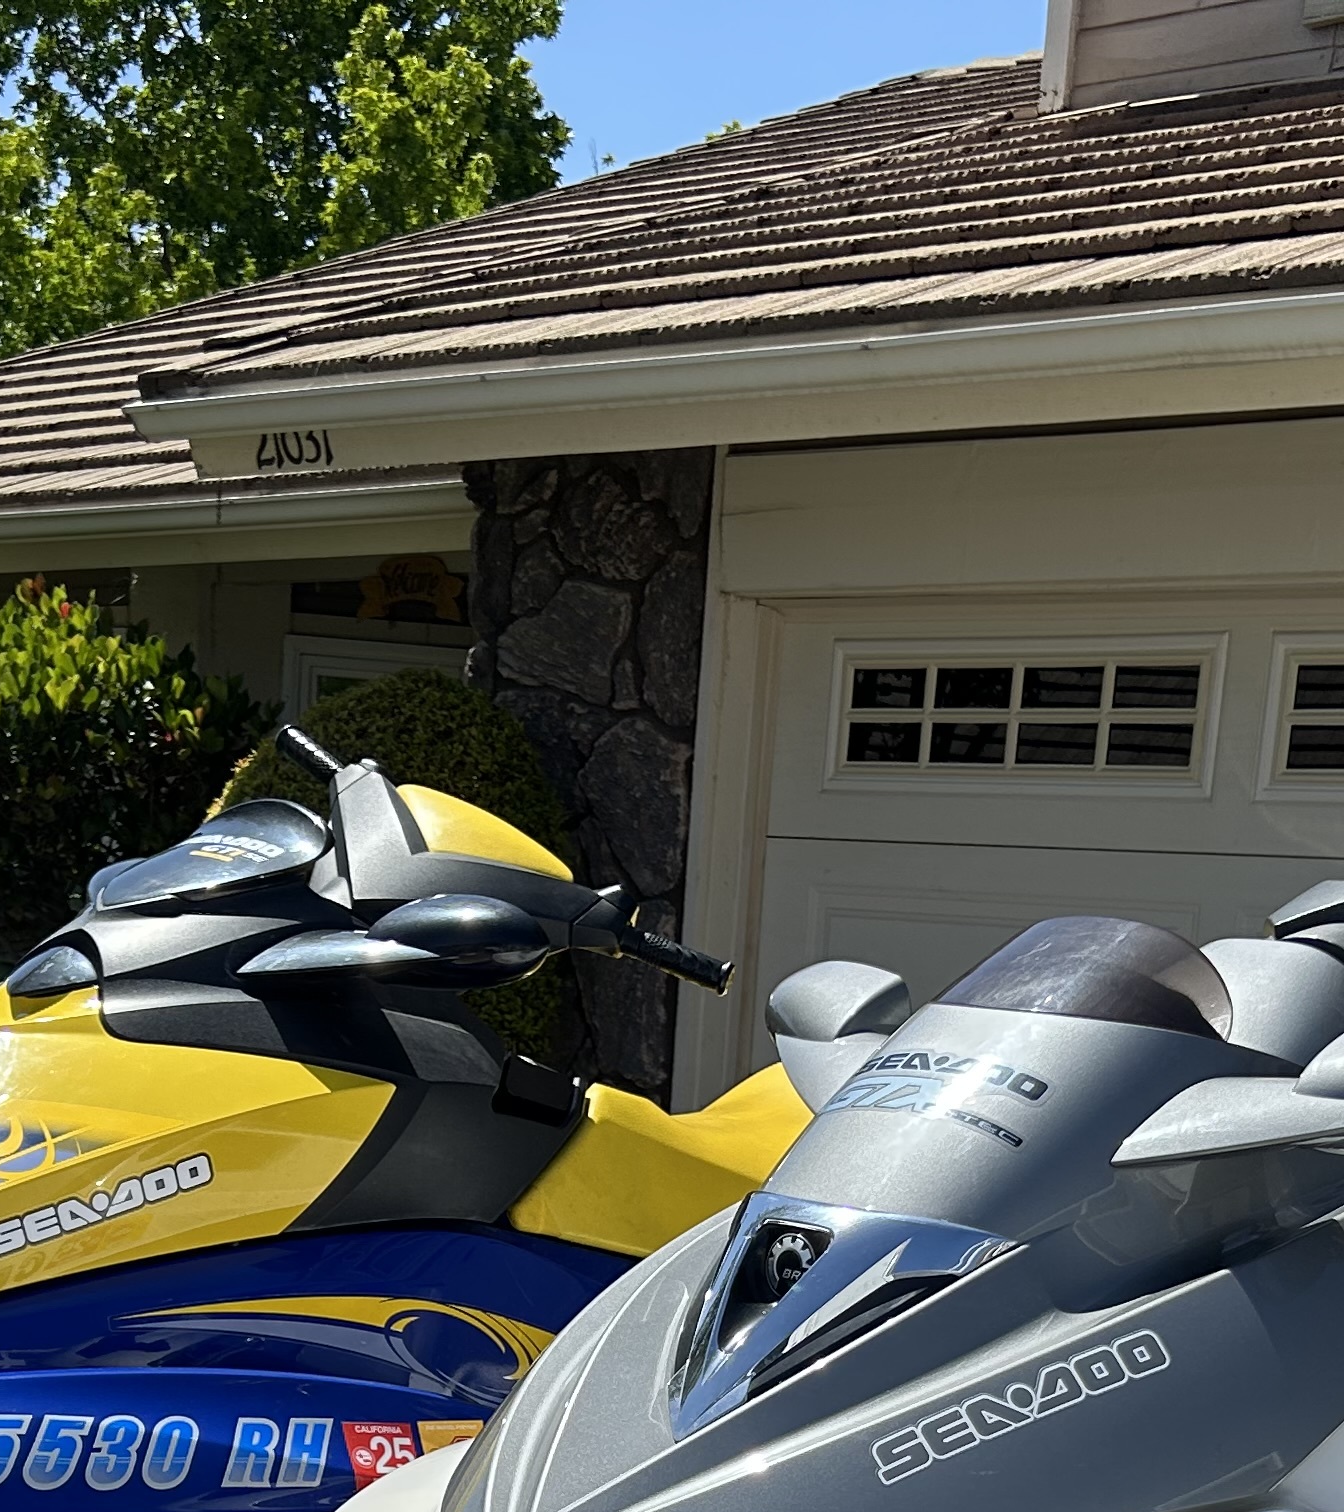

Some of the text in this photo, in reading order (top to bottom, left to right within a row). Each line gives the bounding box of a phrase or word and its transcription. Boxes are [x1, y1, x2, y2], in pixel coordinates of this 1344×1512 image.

[354, 1425, 403, 1435] CALIFORNIA
[221, 1417, 335, 1489] RH
[370, 1435, 416, 1475] 25
